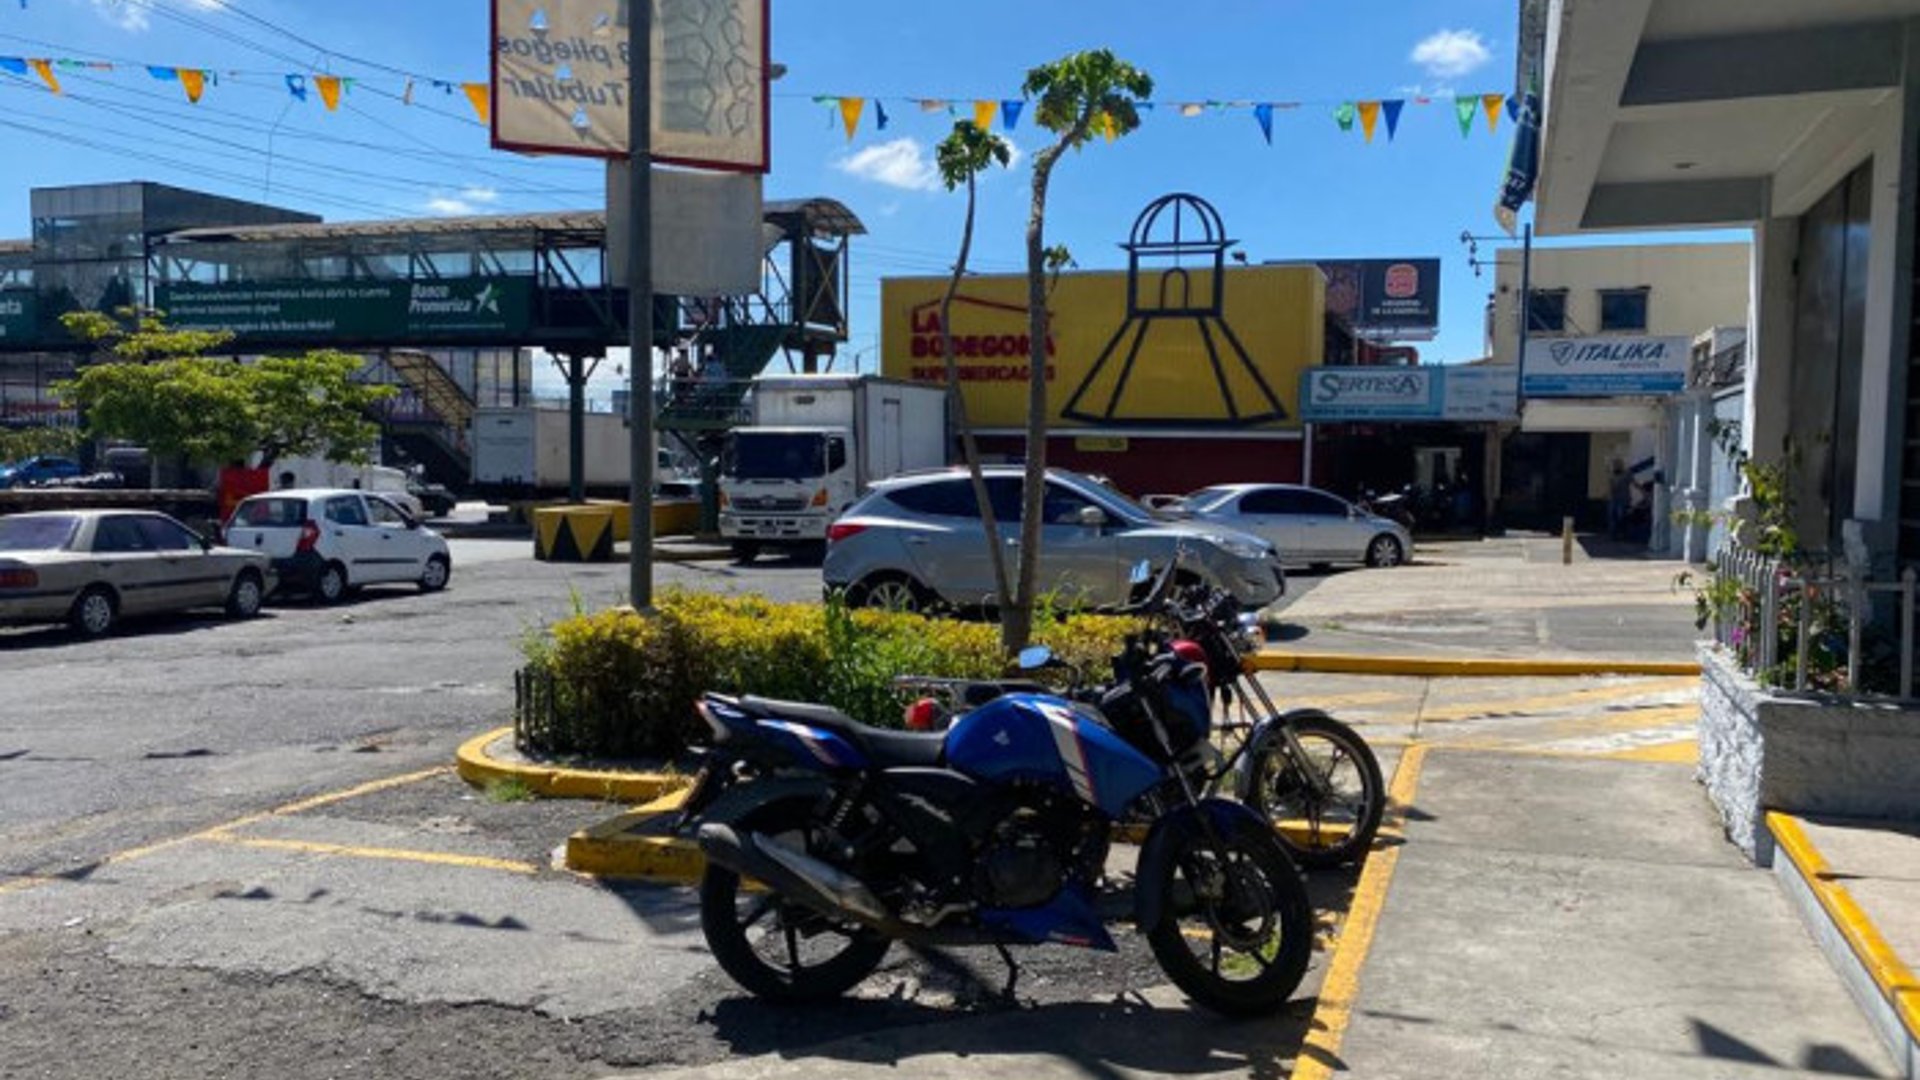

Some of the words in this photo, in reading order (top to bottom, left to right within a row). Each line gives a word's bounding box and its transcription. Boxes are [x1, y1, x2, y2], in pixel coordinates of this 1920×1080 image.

[410, 283, 449, 298] Banco
[408, 296, 472, 314] Promerica
[911, 309, 942, 333] LA
[1574, 342, 1665, 362] ITALIKA
[1315, 373, 1422, 401] SERTESA
